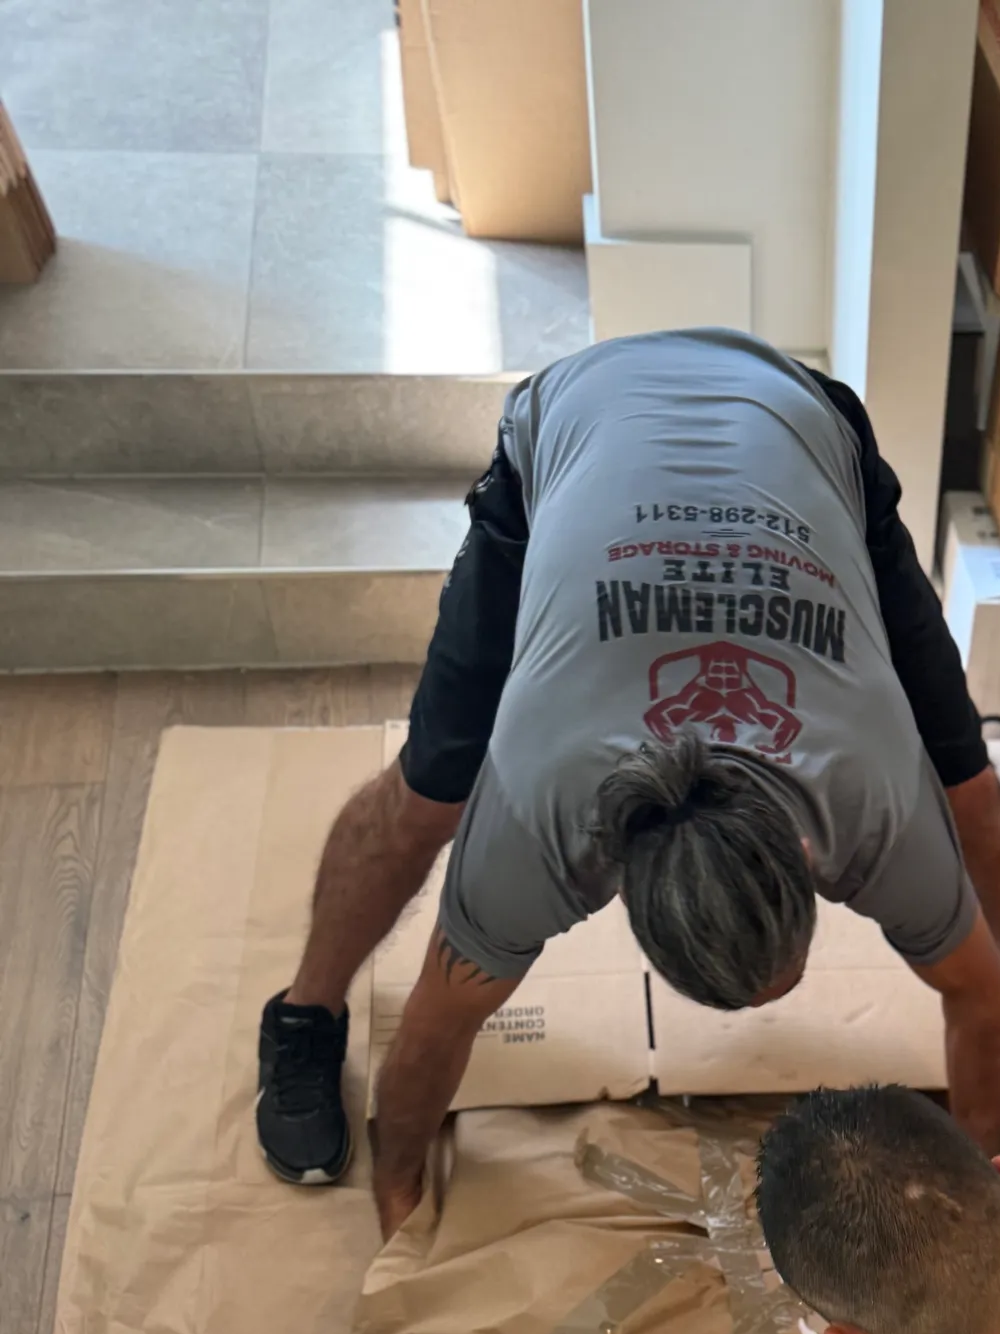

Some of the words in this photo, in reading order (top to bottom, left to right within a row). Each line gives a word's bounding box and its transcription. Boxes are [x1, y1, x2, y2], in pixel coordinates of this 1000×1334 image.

[634, 504, 810, 542] 512-298-5311
[607, 540, 720, 562] STORAGE
[726, 544, 742, 558] &
[662, 560, 790, 590] ELITE
[747, 544, 835, 588] MOVING
[595, 580, 847, 664] MUSCLEMAN
[494, 1006, 544, 1018] ORDER
[503, 1032, 545, 1043] NAME
